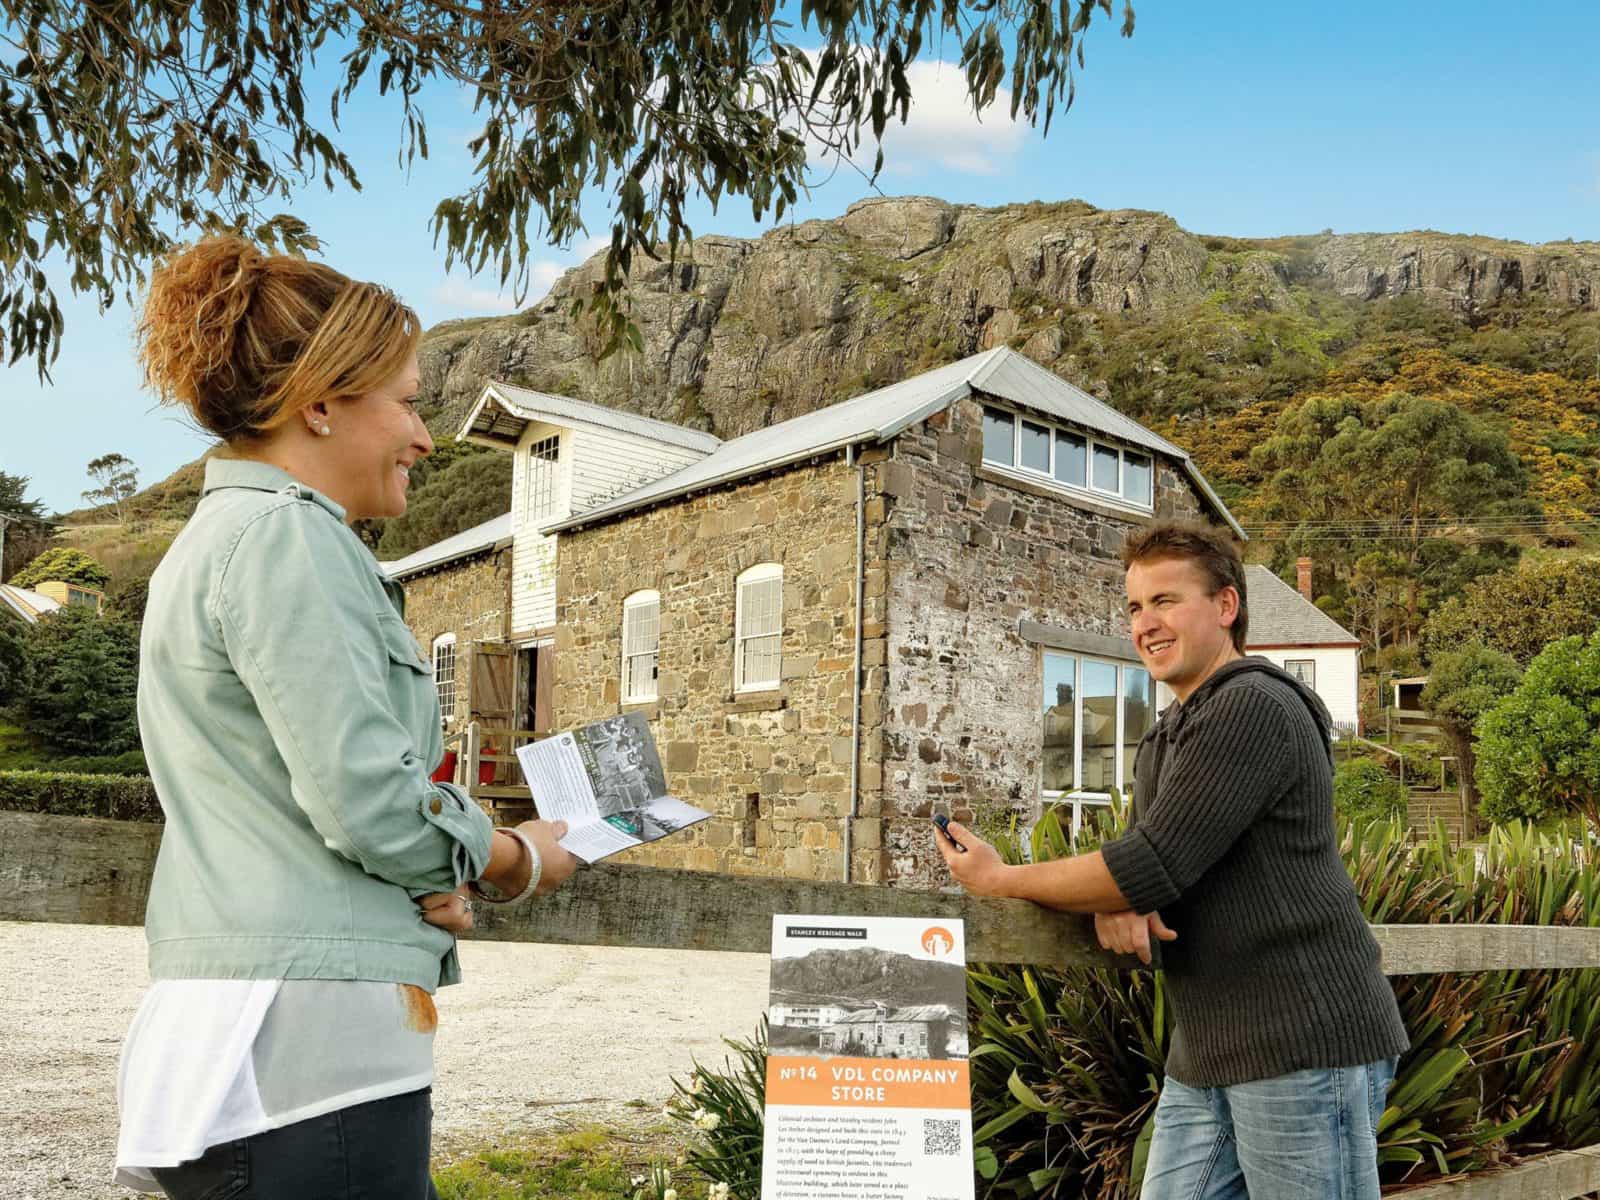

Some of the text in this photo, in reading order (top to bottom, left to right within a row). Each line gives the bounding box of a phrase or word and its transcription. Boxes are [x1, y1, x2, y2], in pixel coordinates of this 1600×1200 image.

[799, 1066, 817, 1081] 14
[831, 1066, 865, 1082] VDL
[871, 1068, 959, 1084] COMPANY
[831, 1086, 886, 1101] STORE
[807, 1126, 830, 1135] designed
